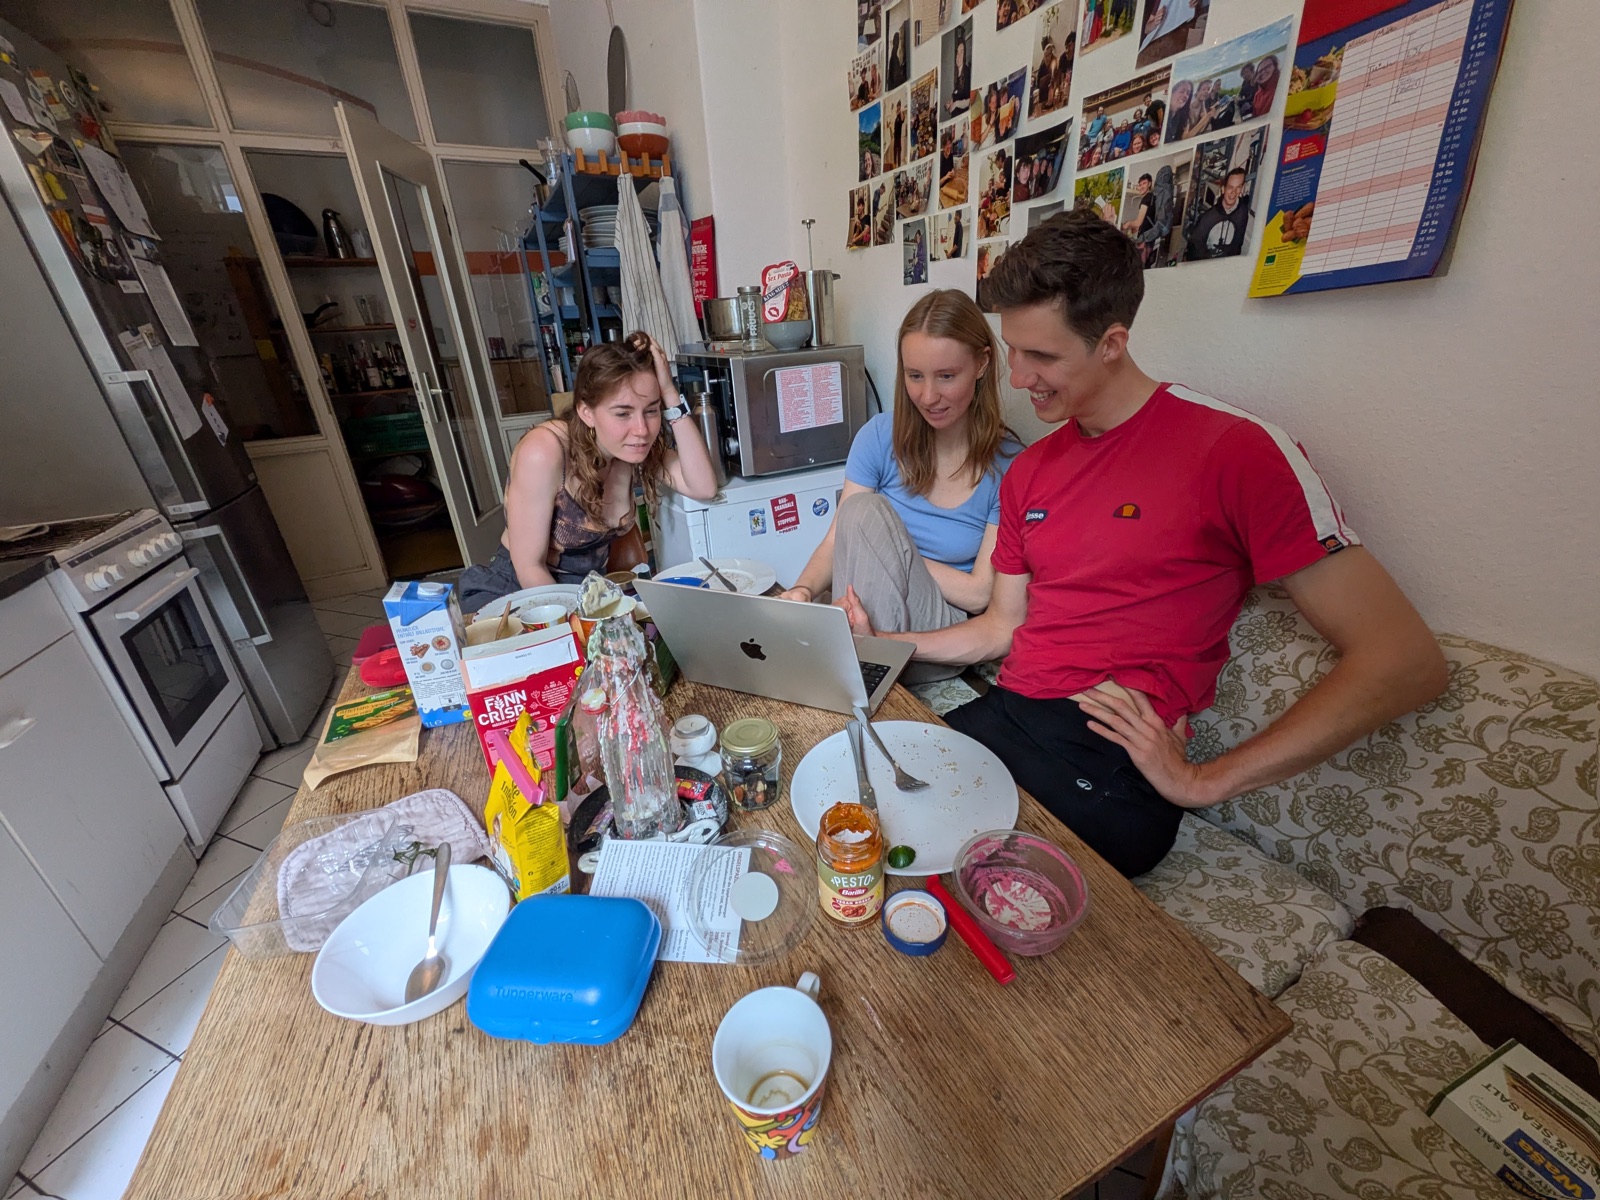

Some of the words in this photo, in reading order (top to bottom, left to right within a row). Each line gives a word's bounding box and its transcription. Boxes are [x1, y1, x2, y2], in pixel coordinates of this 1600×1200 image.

[777, 271, 792, 280] Pasta
[774, 501, 794, 511] SKANDALE
[478, 704, 524, 726] CRISP
[834, 874, 872, 888] PESTO
[841, 888, 865, 896] Barilla
[495, 985, 574, 1003] Tupperware
[1480, 1082, 1519, 1113] SALT
[1522, 1110, 1556, 1139] SEA
[1474, 1127, 1504, 1150] SALT
[1556, 1137, 1567, 1149] &
[1502, 1148, 1528, 1171] SEA
[1542, 1137, 1587, 1176] CRISPS
[1518, 1137, 1583, 1199] Wasa
